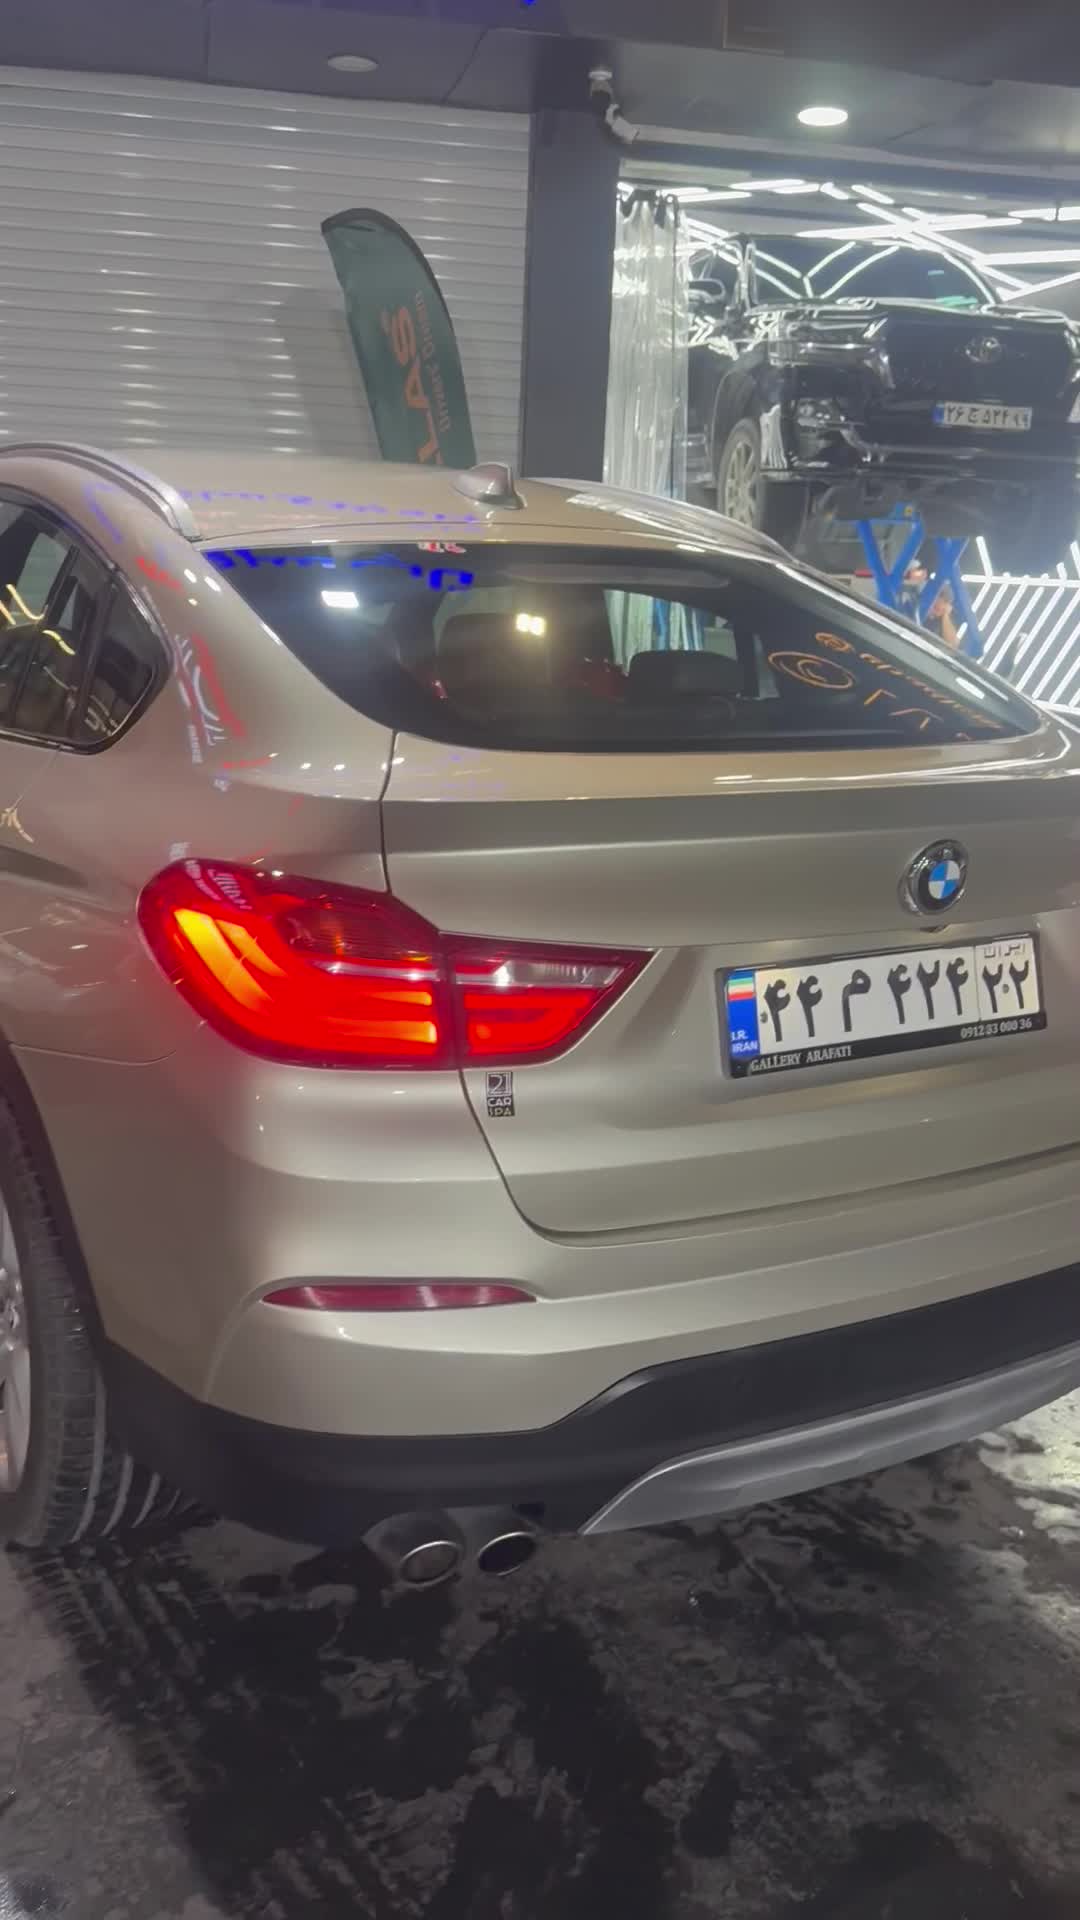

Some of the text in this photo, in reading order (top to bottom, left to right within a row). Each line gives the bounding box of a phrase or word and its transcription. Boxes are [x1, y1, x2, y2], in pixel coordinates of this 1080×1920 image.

[764, 957, 1029, 1042] ۴۴ م ۴۲۴ ۲۲
[732, 1040, 758, 1052] IRAN
[751, 1045, 852, 1071] GALLERY ARAFATI
[488, 1097, 511, 1107] CAR
